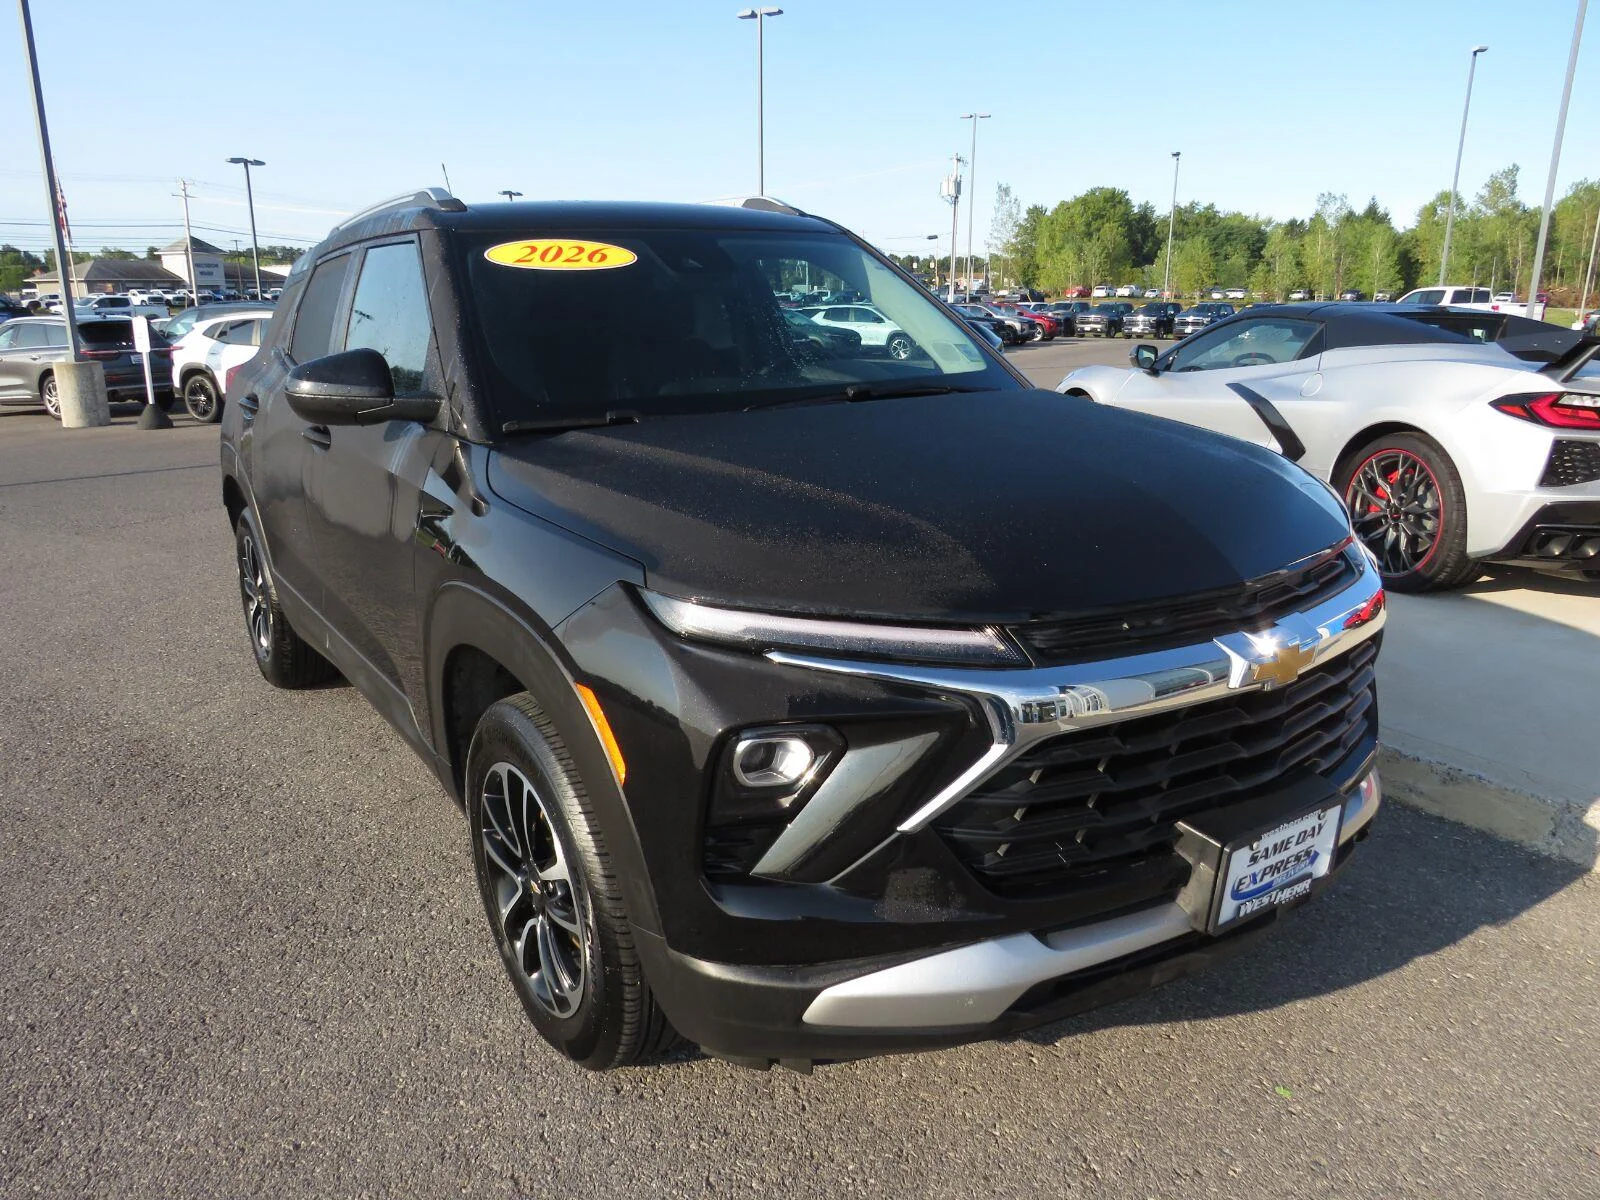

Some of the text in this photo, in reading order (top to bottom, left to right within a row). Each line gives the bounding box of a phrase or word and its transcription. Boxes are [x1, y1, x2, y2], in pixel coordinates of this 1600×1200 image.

[514, 245, 610, 263] 2026
[1247, 820, 1327, 867] SAME DAY
[1237, 844, 1315, 891] EXPRESS
